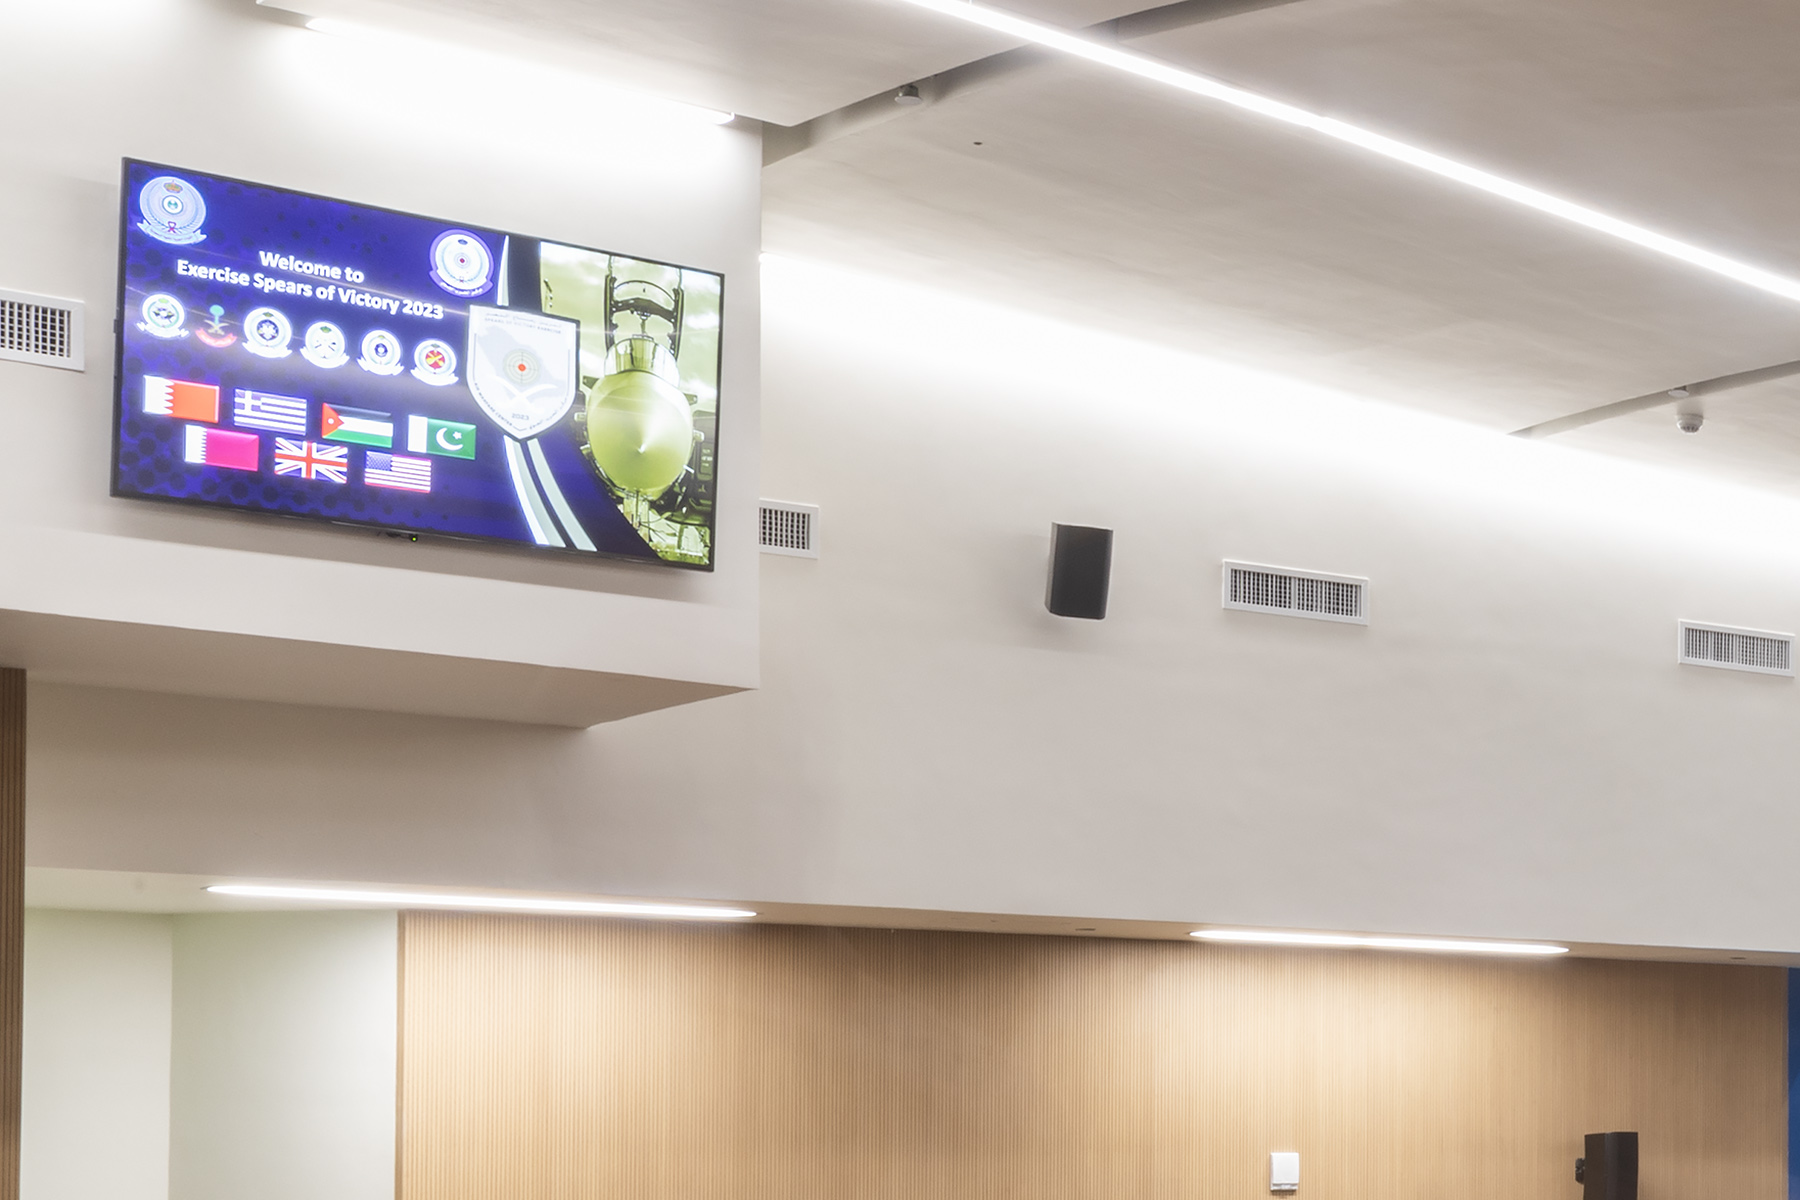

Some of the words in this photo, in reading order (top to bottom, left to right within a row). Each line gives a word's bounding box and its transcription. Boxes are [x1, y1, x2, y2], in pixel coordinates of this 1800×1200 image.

[177, 259, 250, 286] Exercise
[253, 272, 313, 297] Spears
[315, 285, 336, 301] of
[338, 287, 400, 315] Victory
[402, 300, 444, 320] 2023
[259, 250, 342, 279] Welcome
[344, 267, 365, 283] to
